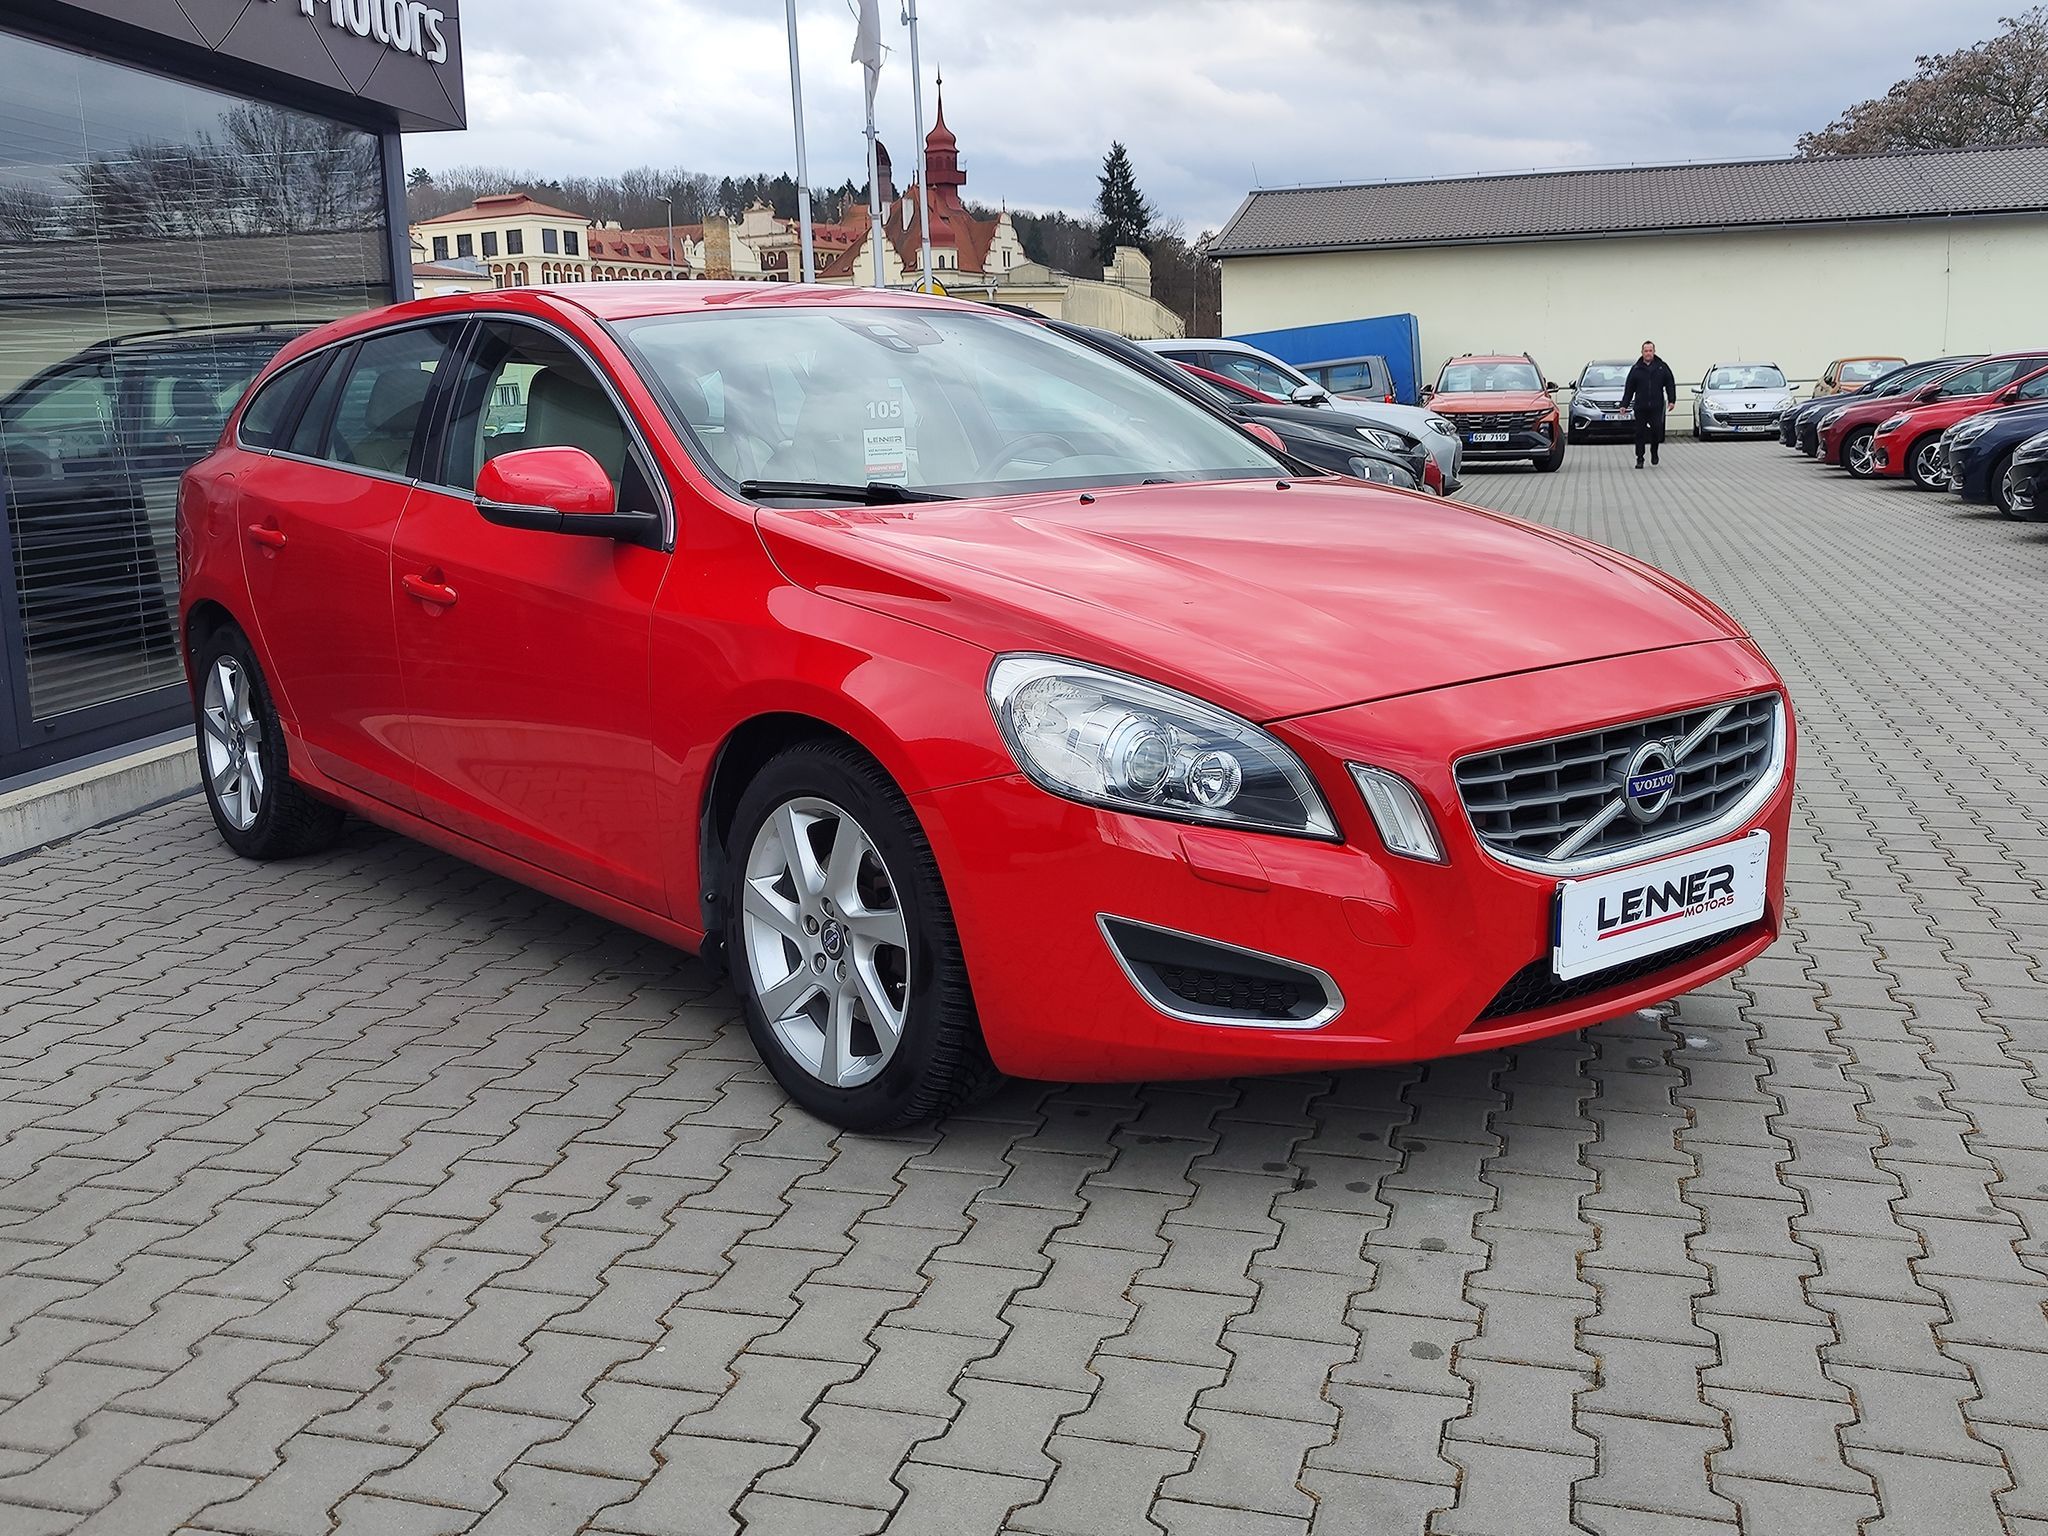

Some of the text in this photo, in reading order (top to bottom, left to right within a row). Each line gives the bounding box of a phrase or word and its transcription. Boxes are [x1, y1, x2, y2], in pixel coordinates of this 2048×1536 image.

[865, 400, 901, 419] 105
[1632, 773, 1674, 792] VOLVO
[1597, 864, 1735, 932] LENNER
[1684, 894, 1735, 918] MOTORS
